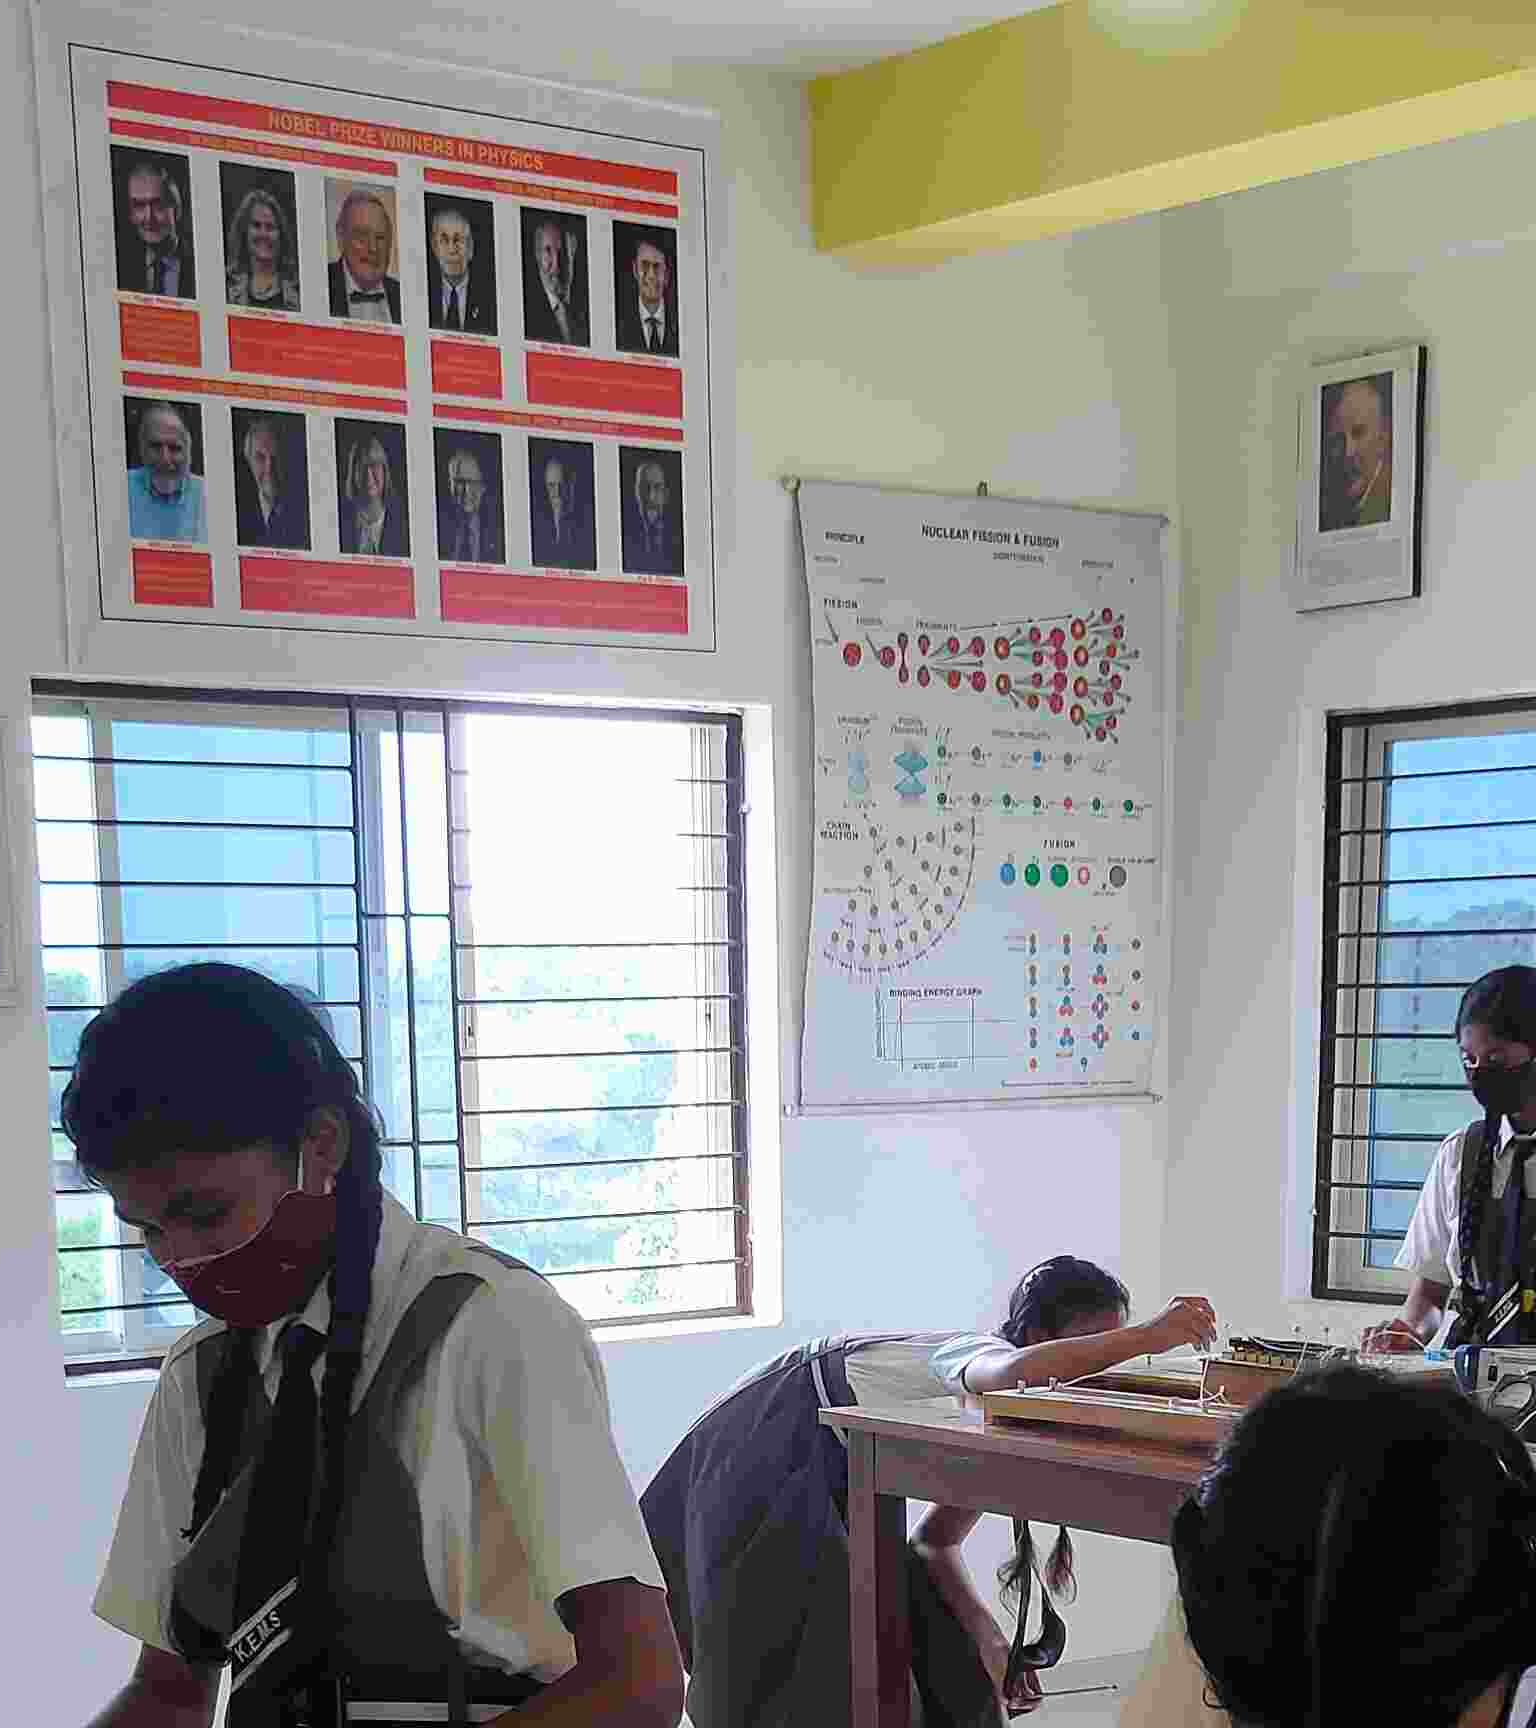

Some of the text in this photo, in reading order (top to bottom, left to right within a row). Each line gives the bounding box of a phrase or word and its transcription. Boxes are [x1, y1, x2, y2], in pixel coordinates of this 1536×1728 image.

[270, 111, 545, 170] NOBEL PRIZE WINNERS IN PHYSICS
[920, 523, 969, 542] NUCLEAR
[971, 529, 1010, 544] FISSION
[1024, 533, 1061, 550] FUSION
[924, 986, 953, 998] ENERGY
